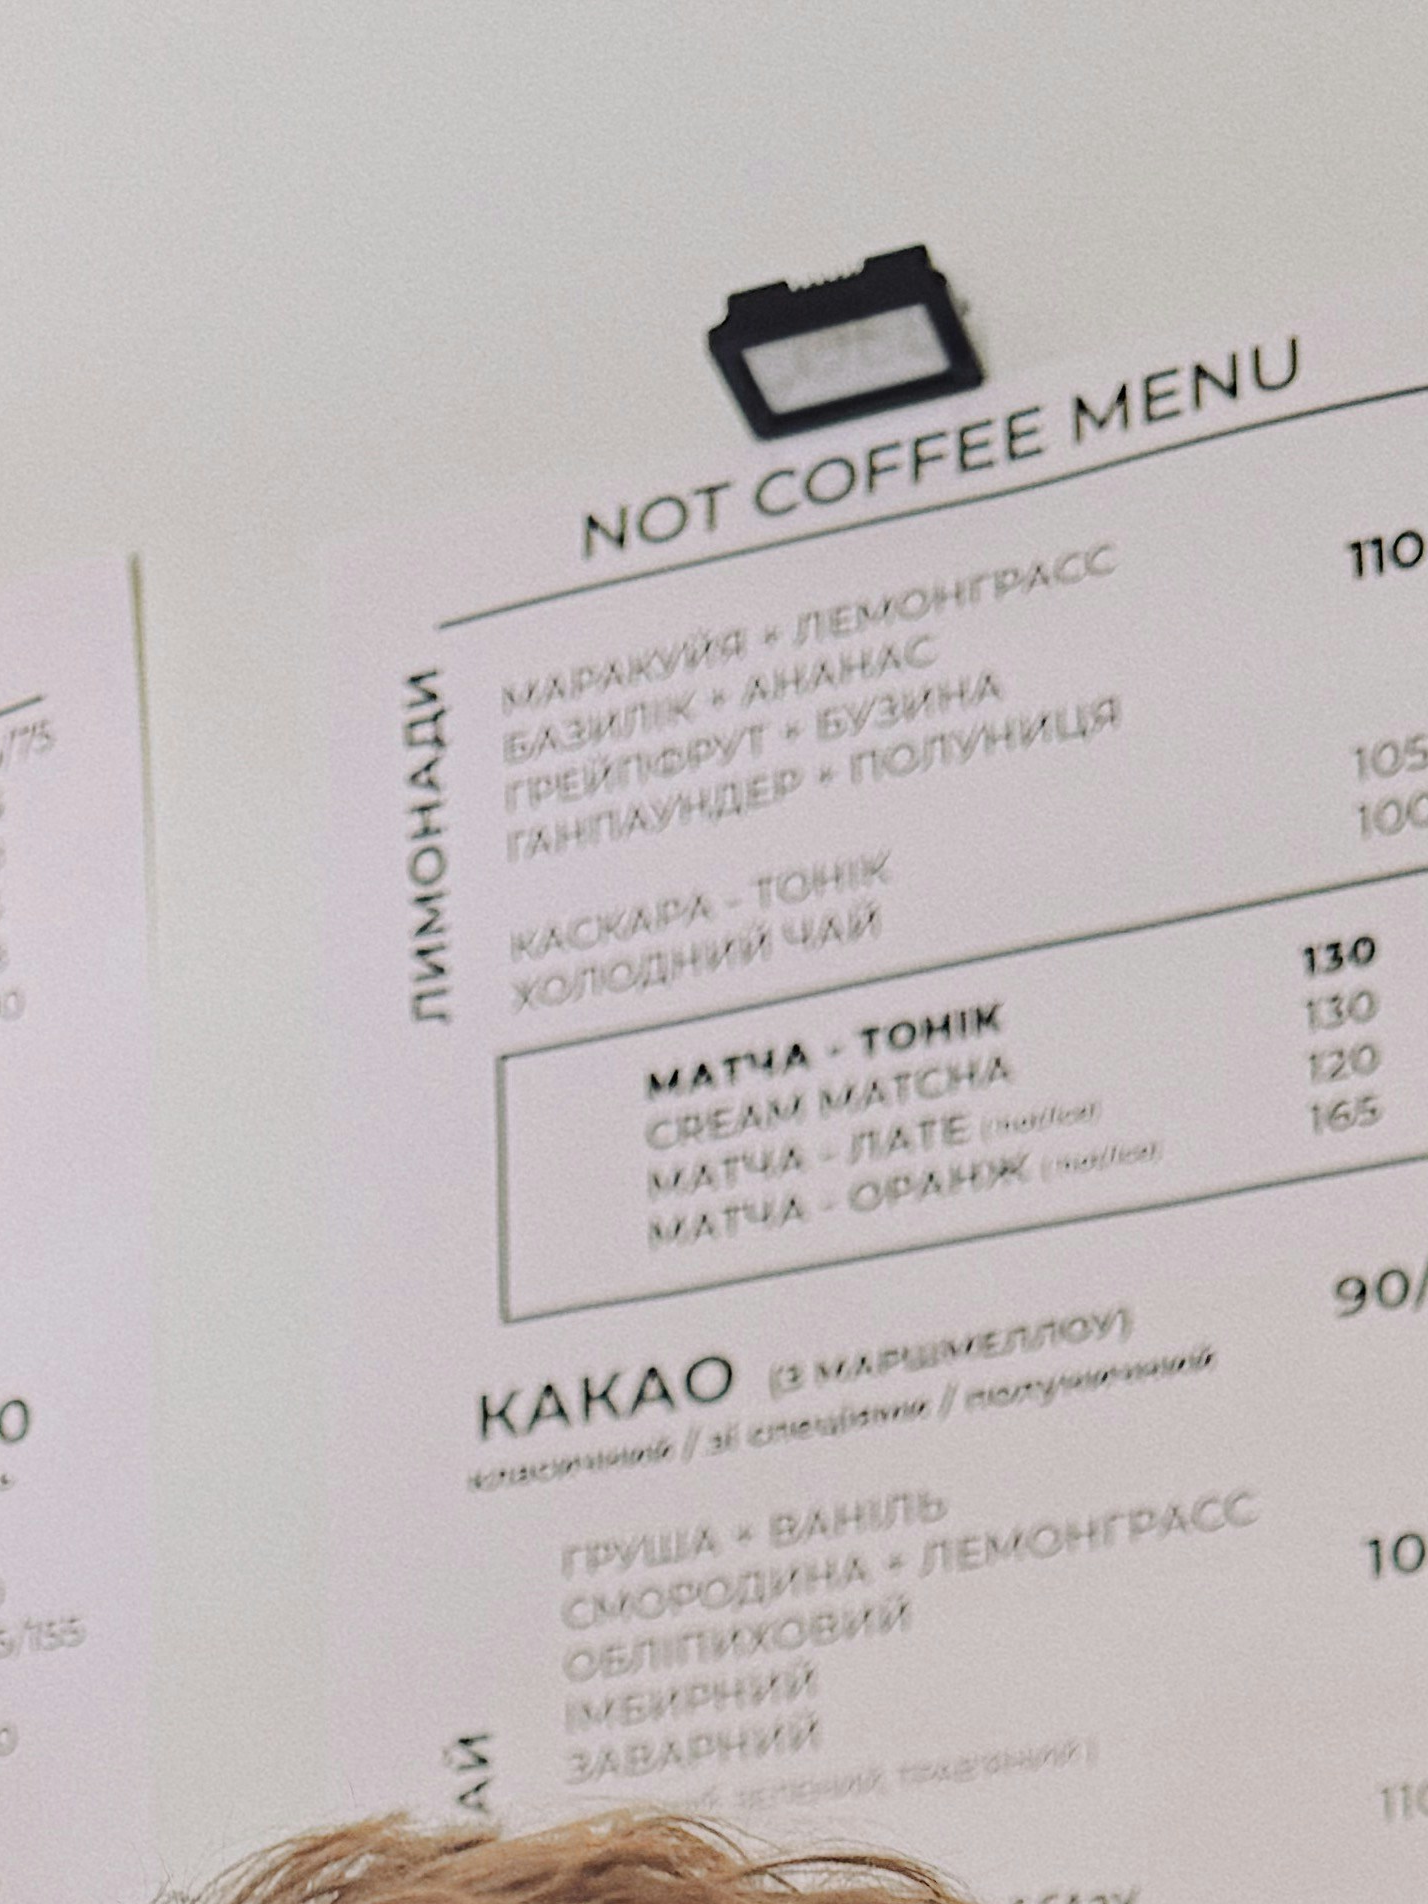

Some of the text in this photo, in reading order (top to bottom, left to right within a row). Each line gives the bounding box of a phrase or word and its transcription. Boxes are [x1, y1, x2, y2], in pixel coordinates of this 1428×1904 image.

[581, 334, 1300, 559] NOT COFFEE MENU
[501, 626, 748, 716] МАРАКУЙЯ
[793, 543, 1120, 648] ЛЕМОНГРАСС
[1347, 529, 1425, 581] 110
[502, 686, 698, 766] БАЗИЛІК
[739, 634, 939, 709] АНАНАС
[504, 719, 769, 814] ГРЕЙПФРУТ
[816, 668, 1004, 743] БУЗИНА
[507, 766, 805, 863] ГАНПАУНДЕР
[849, 697, 1121, 785] ПОЛУНИЦЯ
[400, 668, 454, 1025] ЛИМОНАДИ
[510, 892, 716, 963] КАСКАРА
[750, 850, 892, 909] ТОНІК
[1301, 931, 1381, 978] 130
[512, 902, 884, 1014] ХОЛОДНИЙ ЧАЙ
[645, 1041, 812, 1102] МАТЧА
[860, 1000, 1006, 1056] ТОНІК
[1304, 987, 1381, 1035] 130
[644, 1053, 1014, 1151] CREAM MATCHA
[1307, 1041, 1383, 1086] 120
[646, 1145, 806, 1202] МАТЧА
[848, 1113, 972, 1166] ЛАТЕ
[1310, 1093, 1387, 1137] 165
[646, 1197, 806, 1251] МАТЧА
[848, 1152, 1032, 1213] ОРАНЖ
[478, 1355, 734, 1443] КАКАО
[560, 1524, 720, 1584] ГРУША
[560, 1555, 875, 1632] СМОРОДИНА
[921, 1489, 1261, 1579] ЛЕМОНГРАСС
[565, 1707, 822, 1786] ЗАВАРНИЙ
